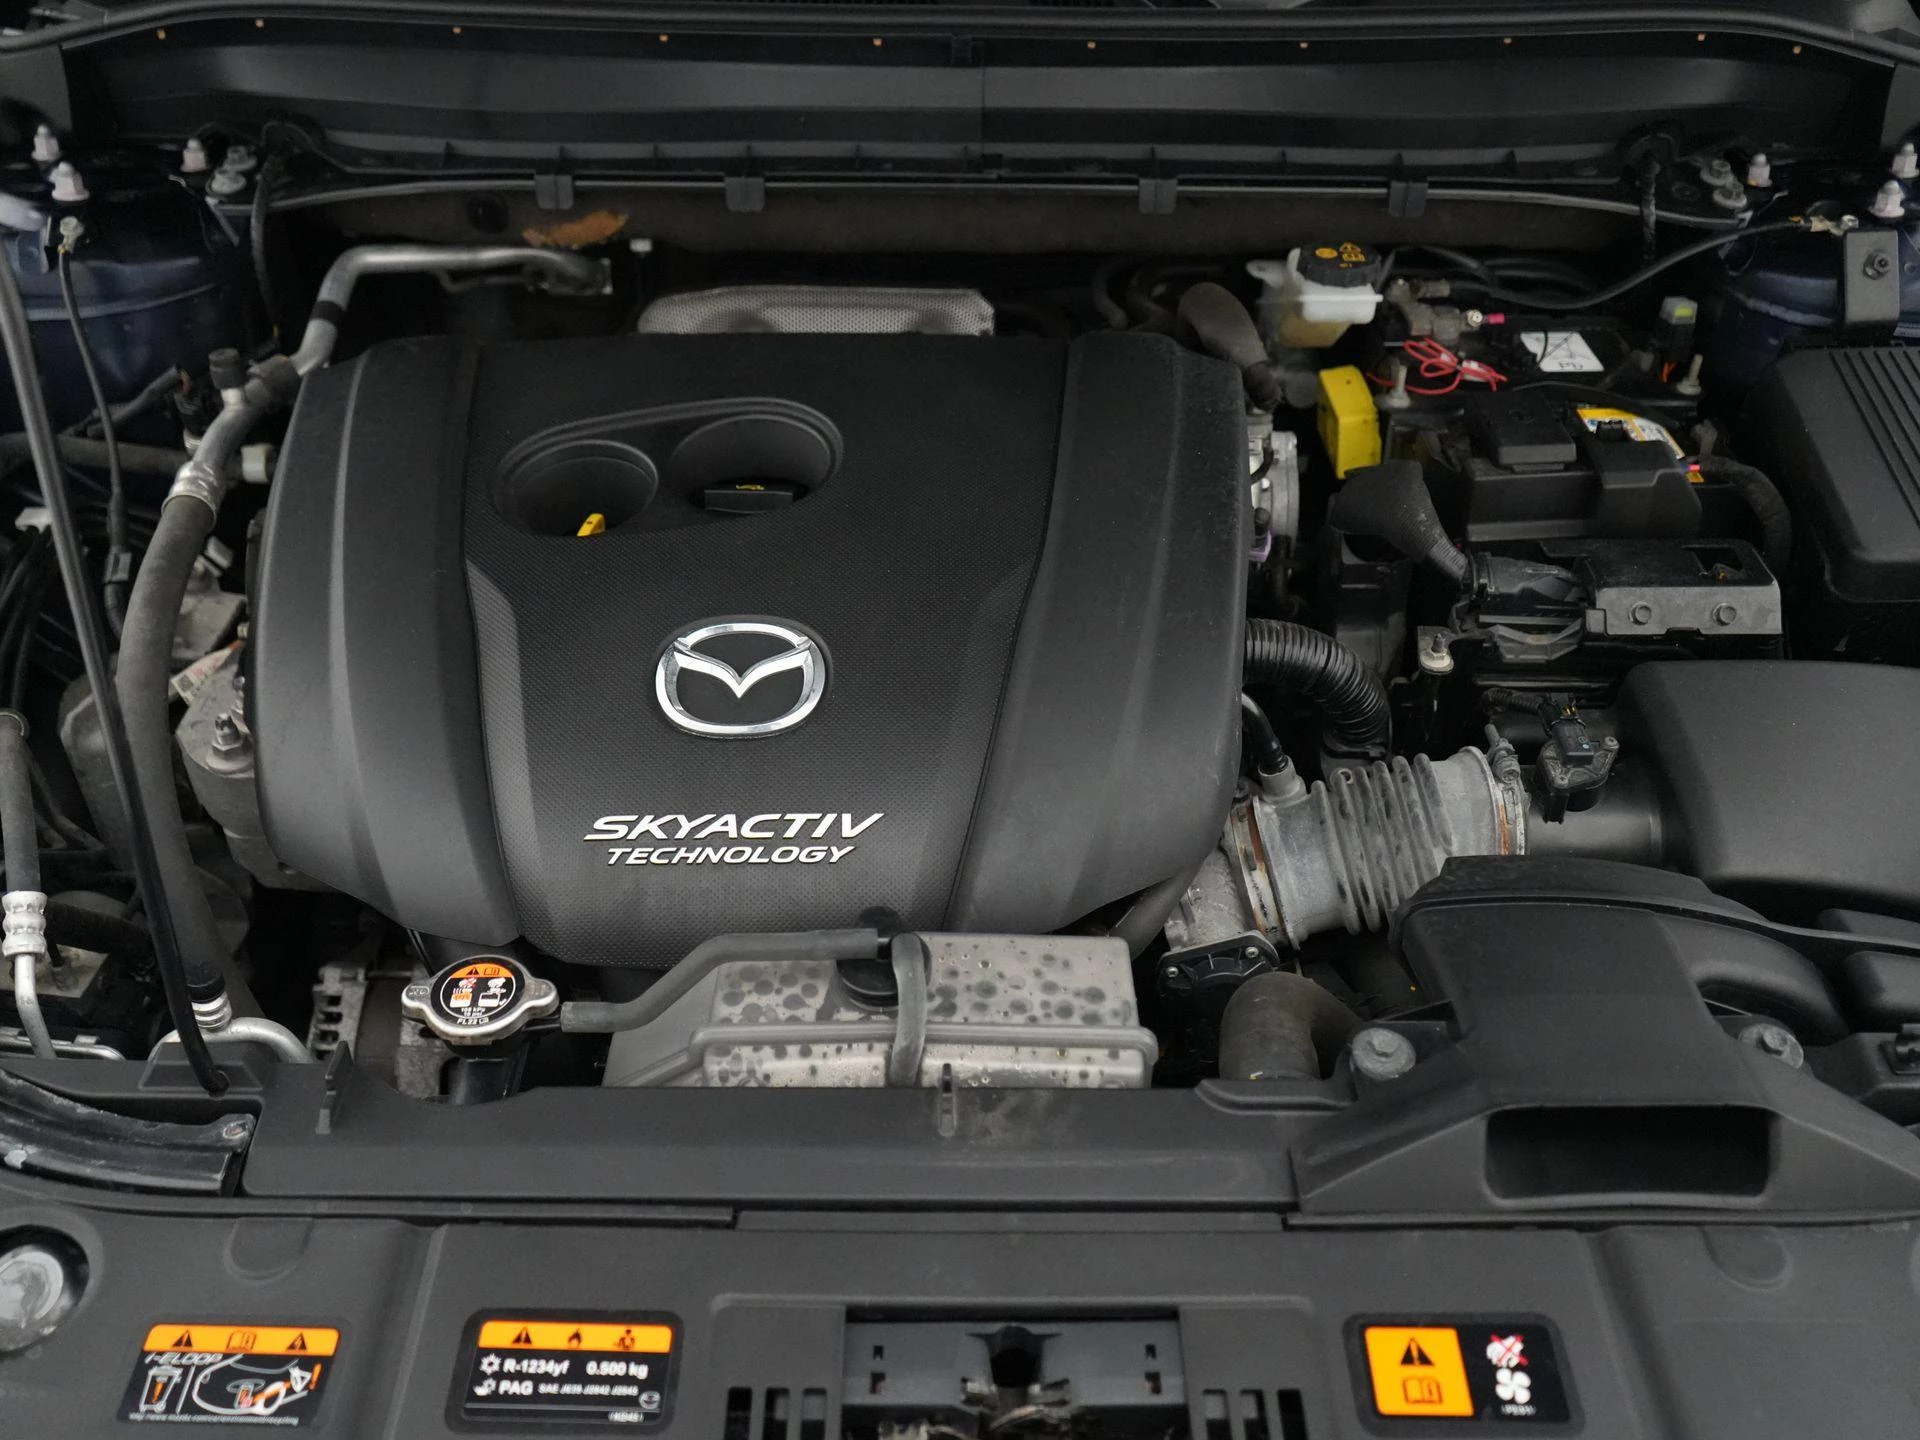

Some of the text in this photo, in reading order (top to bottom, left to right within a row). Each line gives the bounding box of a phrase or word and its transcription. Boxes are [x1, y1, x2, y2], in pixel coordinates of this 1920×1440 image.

[583, 813, 885, 840] SKYACTIV
[607, 846, 856, 864] TECHNOLOGY
[503, 1358, 570, 1377] R-1234yf
[628, 1361, 649, 1380] kg
[498, 1380, 533, 1395] PAG
[538, 1383, 559, 1394] SAE
